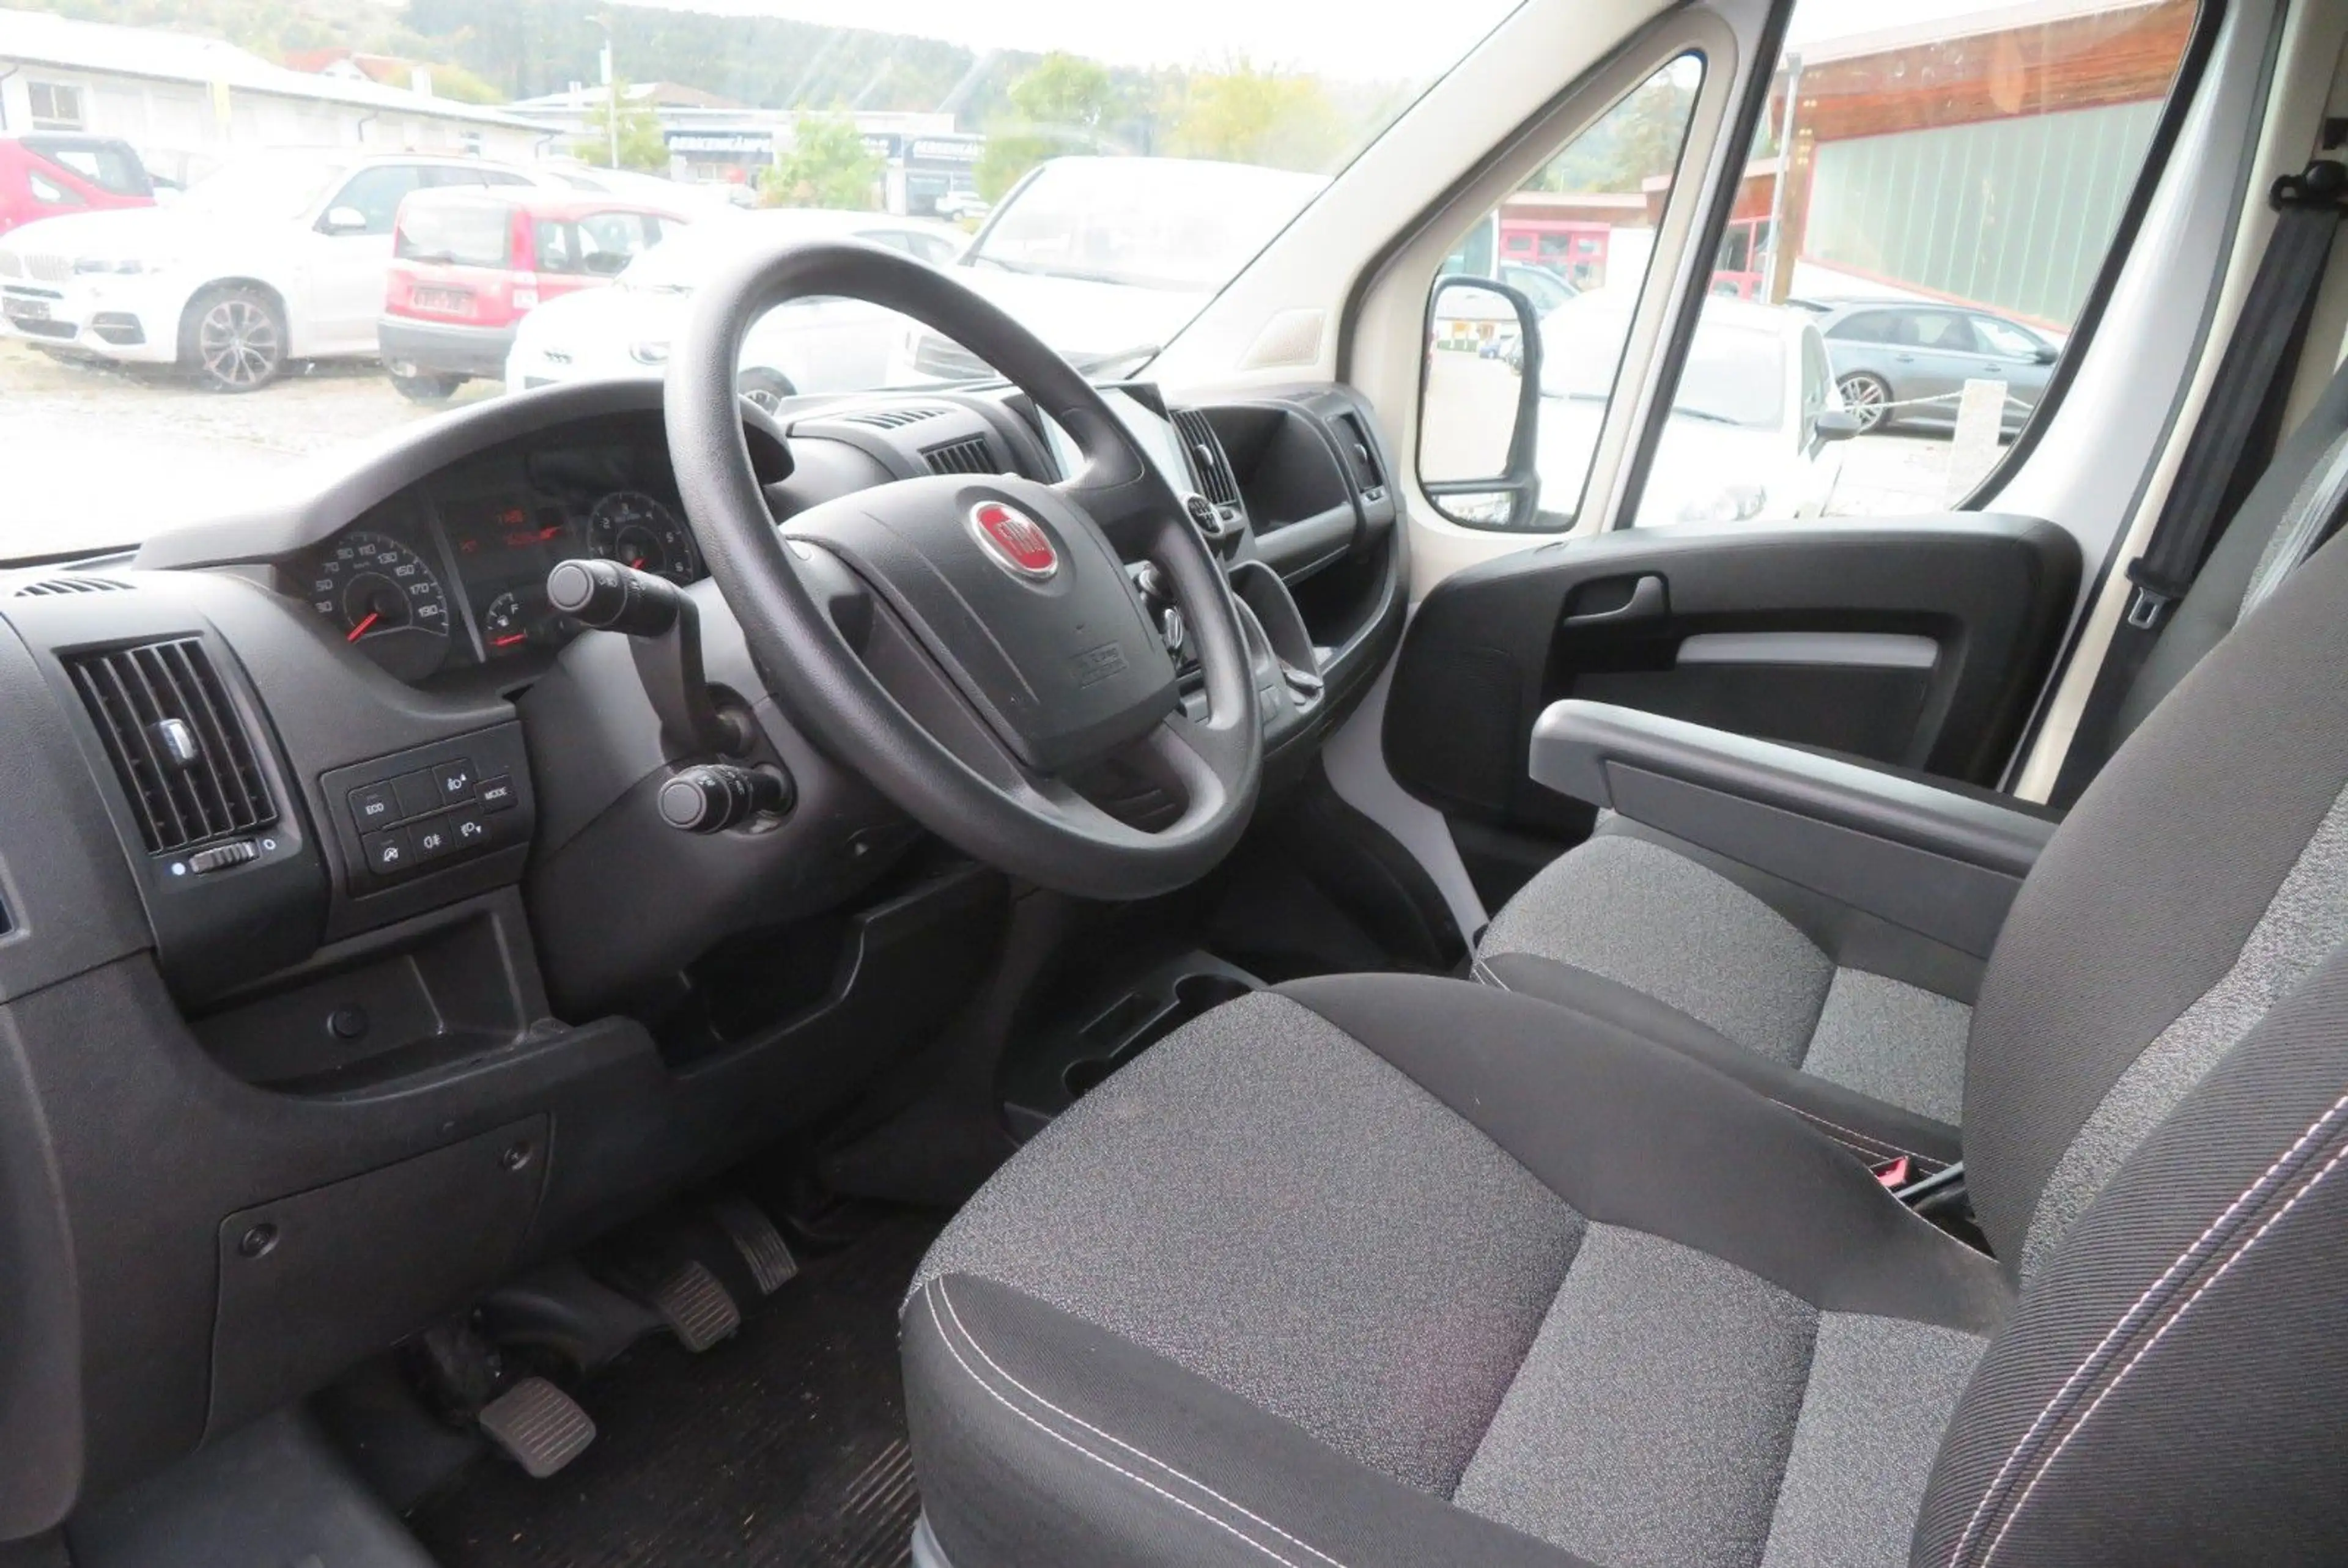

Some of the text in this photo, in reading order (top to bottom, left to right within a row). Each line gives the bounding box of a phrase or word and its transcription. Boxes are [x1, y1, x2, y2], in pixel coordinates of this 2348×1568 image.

[378, 552, 397, 564] 130
[394, 564, 415, 576] 150
[316, 579, 333, 591] 50
[409, 583, 429, 595] 170
[418, 605, 438, 617] 190
[366, 803, 384, 815] ECO
